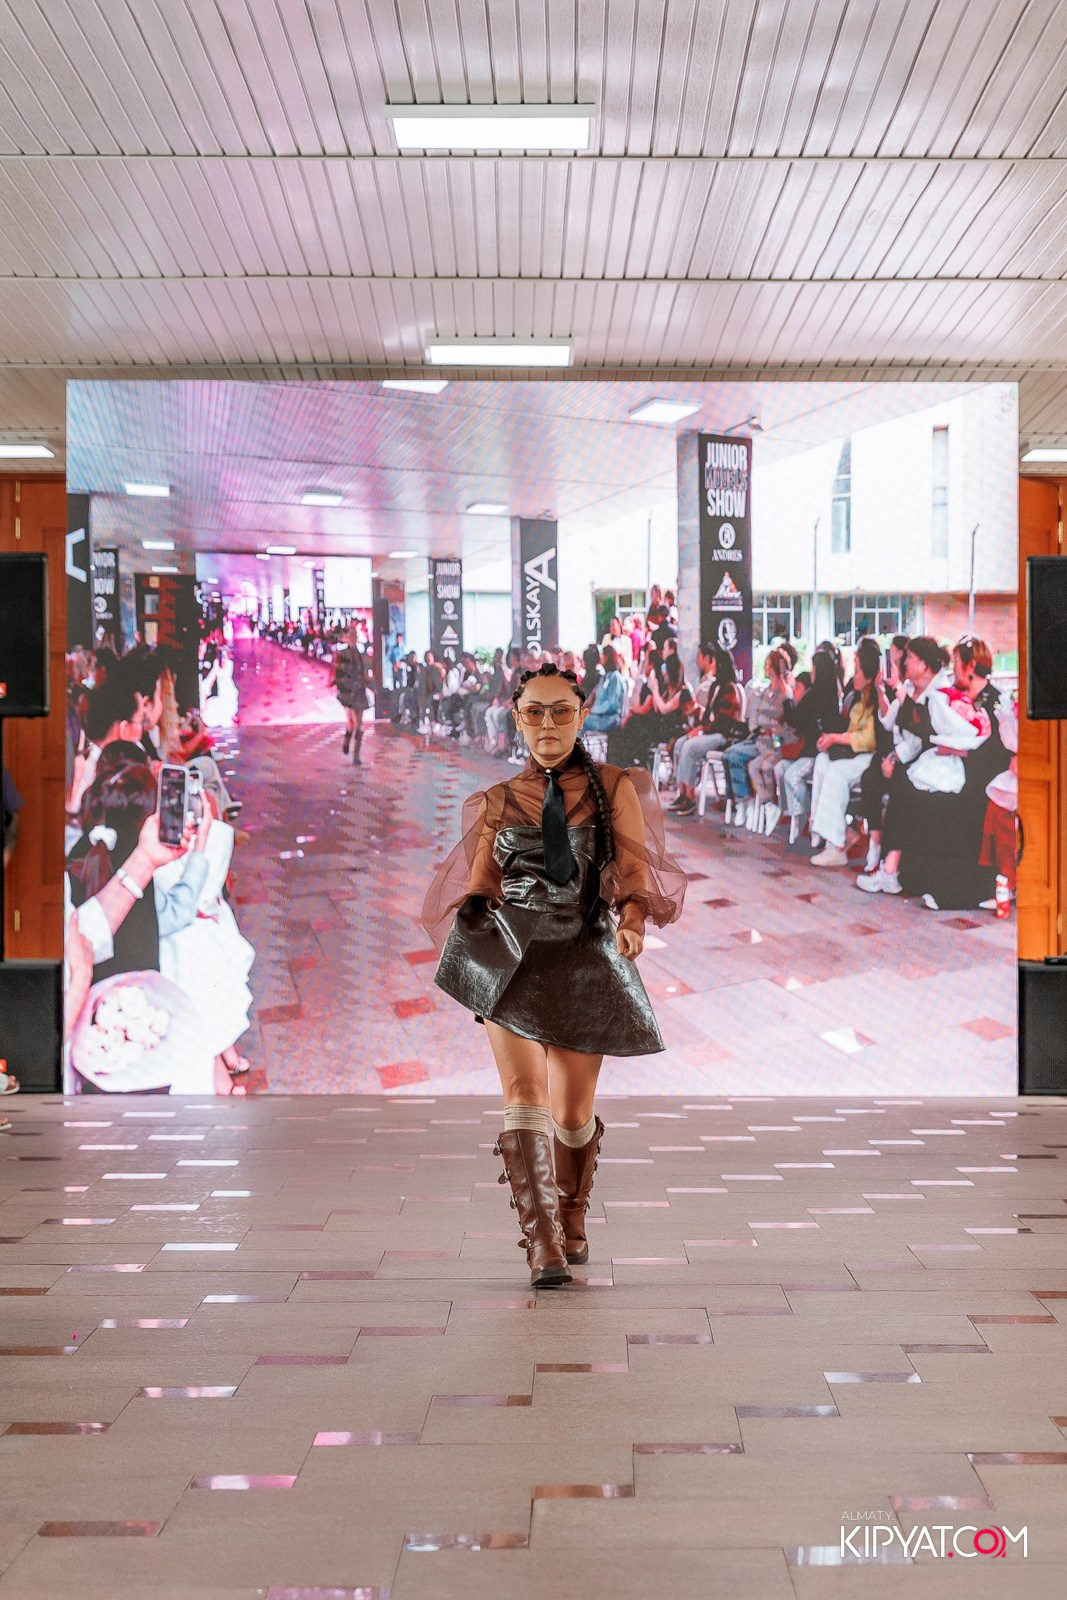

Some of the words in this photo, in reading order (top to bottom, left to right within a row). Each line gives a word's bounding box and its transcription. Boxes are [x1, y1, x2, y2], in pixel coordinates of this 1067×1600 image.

[705, 442, 748, 471] JUNIOR
[706, 489, 747, 518] SHOW
[436, 562, 461, 577] JUNIOR
[436, 584, 460, 599] SHOW
